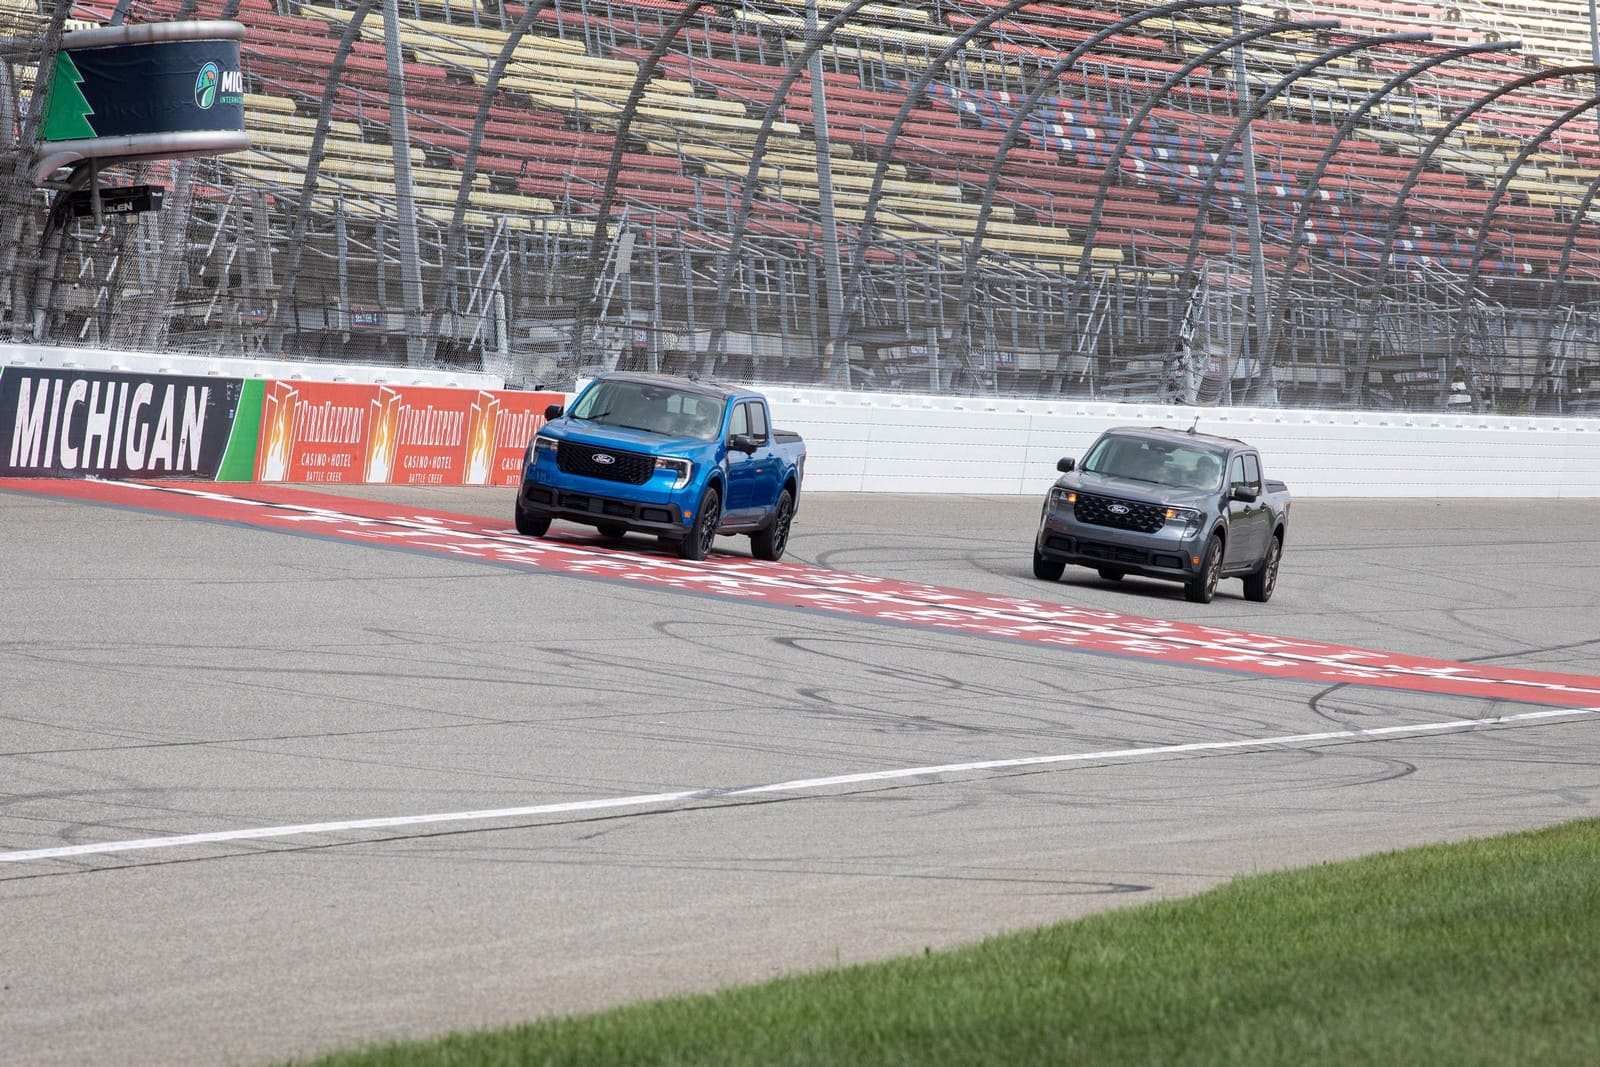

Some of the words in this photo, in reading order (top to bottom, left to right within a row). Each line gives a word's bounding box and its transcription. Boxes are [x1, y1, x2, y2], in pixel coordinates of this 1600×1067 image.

[9, 377, 208, 471] MICHIGAN
[298, 400, 364, 443] FIREKEEPERS
[401, 404, 464, 446] FIREKEEPERS
[301, 452, 327, 467] CASINO
[331, 453, 351, 468] HOTEL
[404, 455, 429, 469] CASINO
[432, 456, 452, 470] HOTEL
[306, 471, 325, 481] BATTLE
[326, 471, 343, 482] CREEK
[408, 473, 426, 483] BATTLE
[427, 473, 443, 484] CREEK
